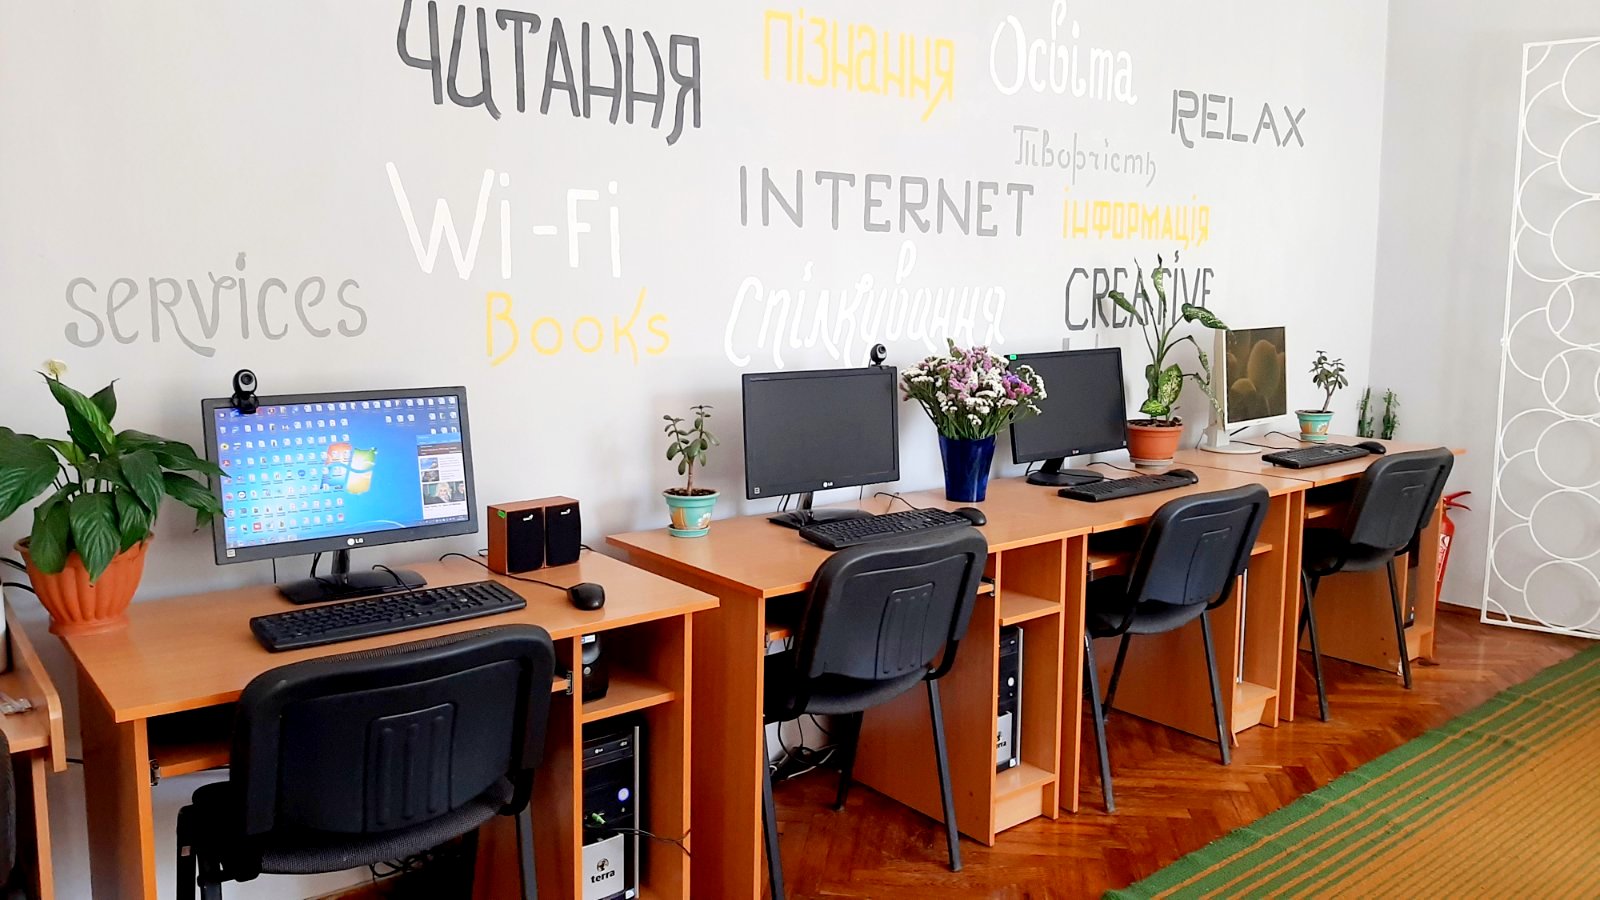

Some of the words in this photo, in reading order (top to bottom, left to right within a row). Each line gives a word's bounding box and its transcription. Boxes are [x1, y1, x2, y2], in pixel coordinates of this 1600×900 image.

[990, 0, 1137, 104] Освіта
[1171, 89, 1306, 149] RELAX
[386, 162, 620, 280] Wi-Fi
[740, 165, 1034, 237] INTERNET
[591, 870, 615, 883] terra
